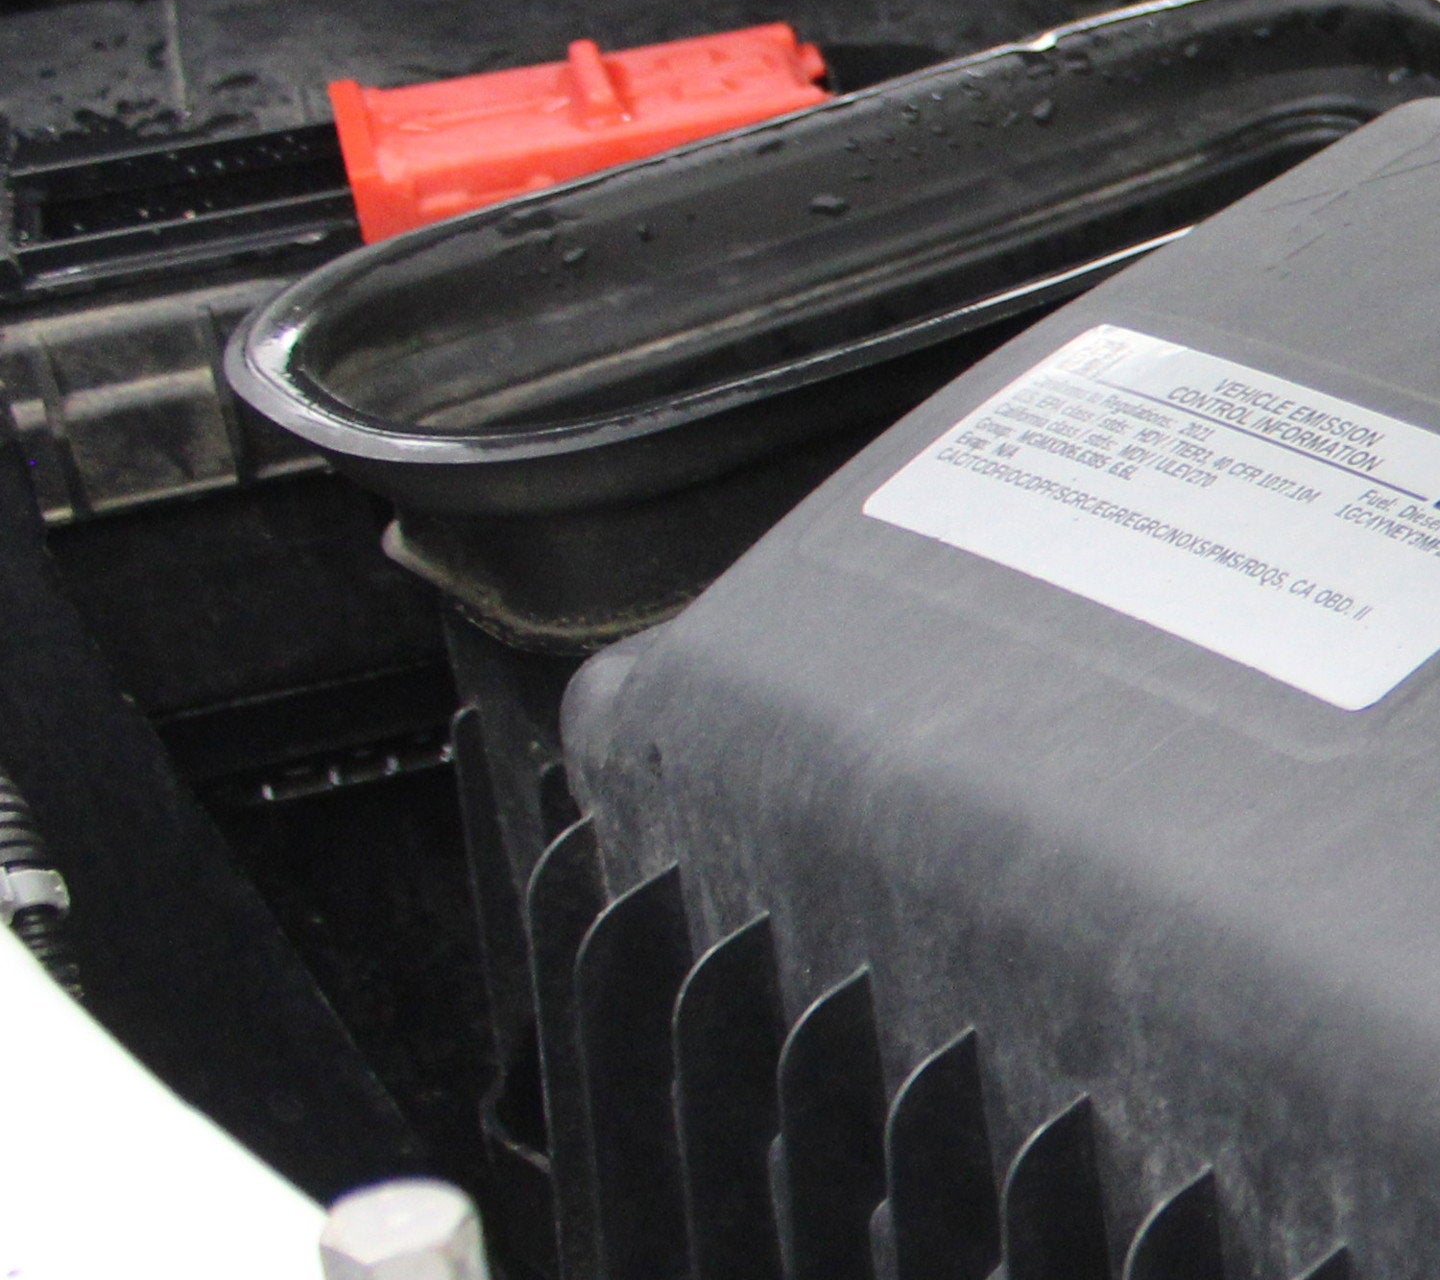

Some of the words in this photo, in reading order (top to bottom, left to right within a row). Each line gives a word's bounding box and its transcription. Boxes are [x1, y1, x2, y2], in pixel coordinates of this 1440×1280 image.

[1165, 386, 1259, 426] CONTROL
[1249, 416, 1386, 472] INFORMATION
[1178, 422, 1218, 442] 2021
[1211, 379, 1297, 415] VEHICLE
[1286, 405, 1387, 448] EMISSION
[1105, 460, 1145, 481] 6.6L
[1116, 444, 1159, 465] MDV
[1152, 457, 1221, 488] ULEV270
[1131, 428, 1172, 448] HDV
[1225, 462, 1265, 483] CFR
[1254, 473, 1323, 505] 1037.104
[1356, 488, 1403, 512] Fuel:
[1286, 578, 1322, 598] CA
[1350, 605, 1375, 621] II
